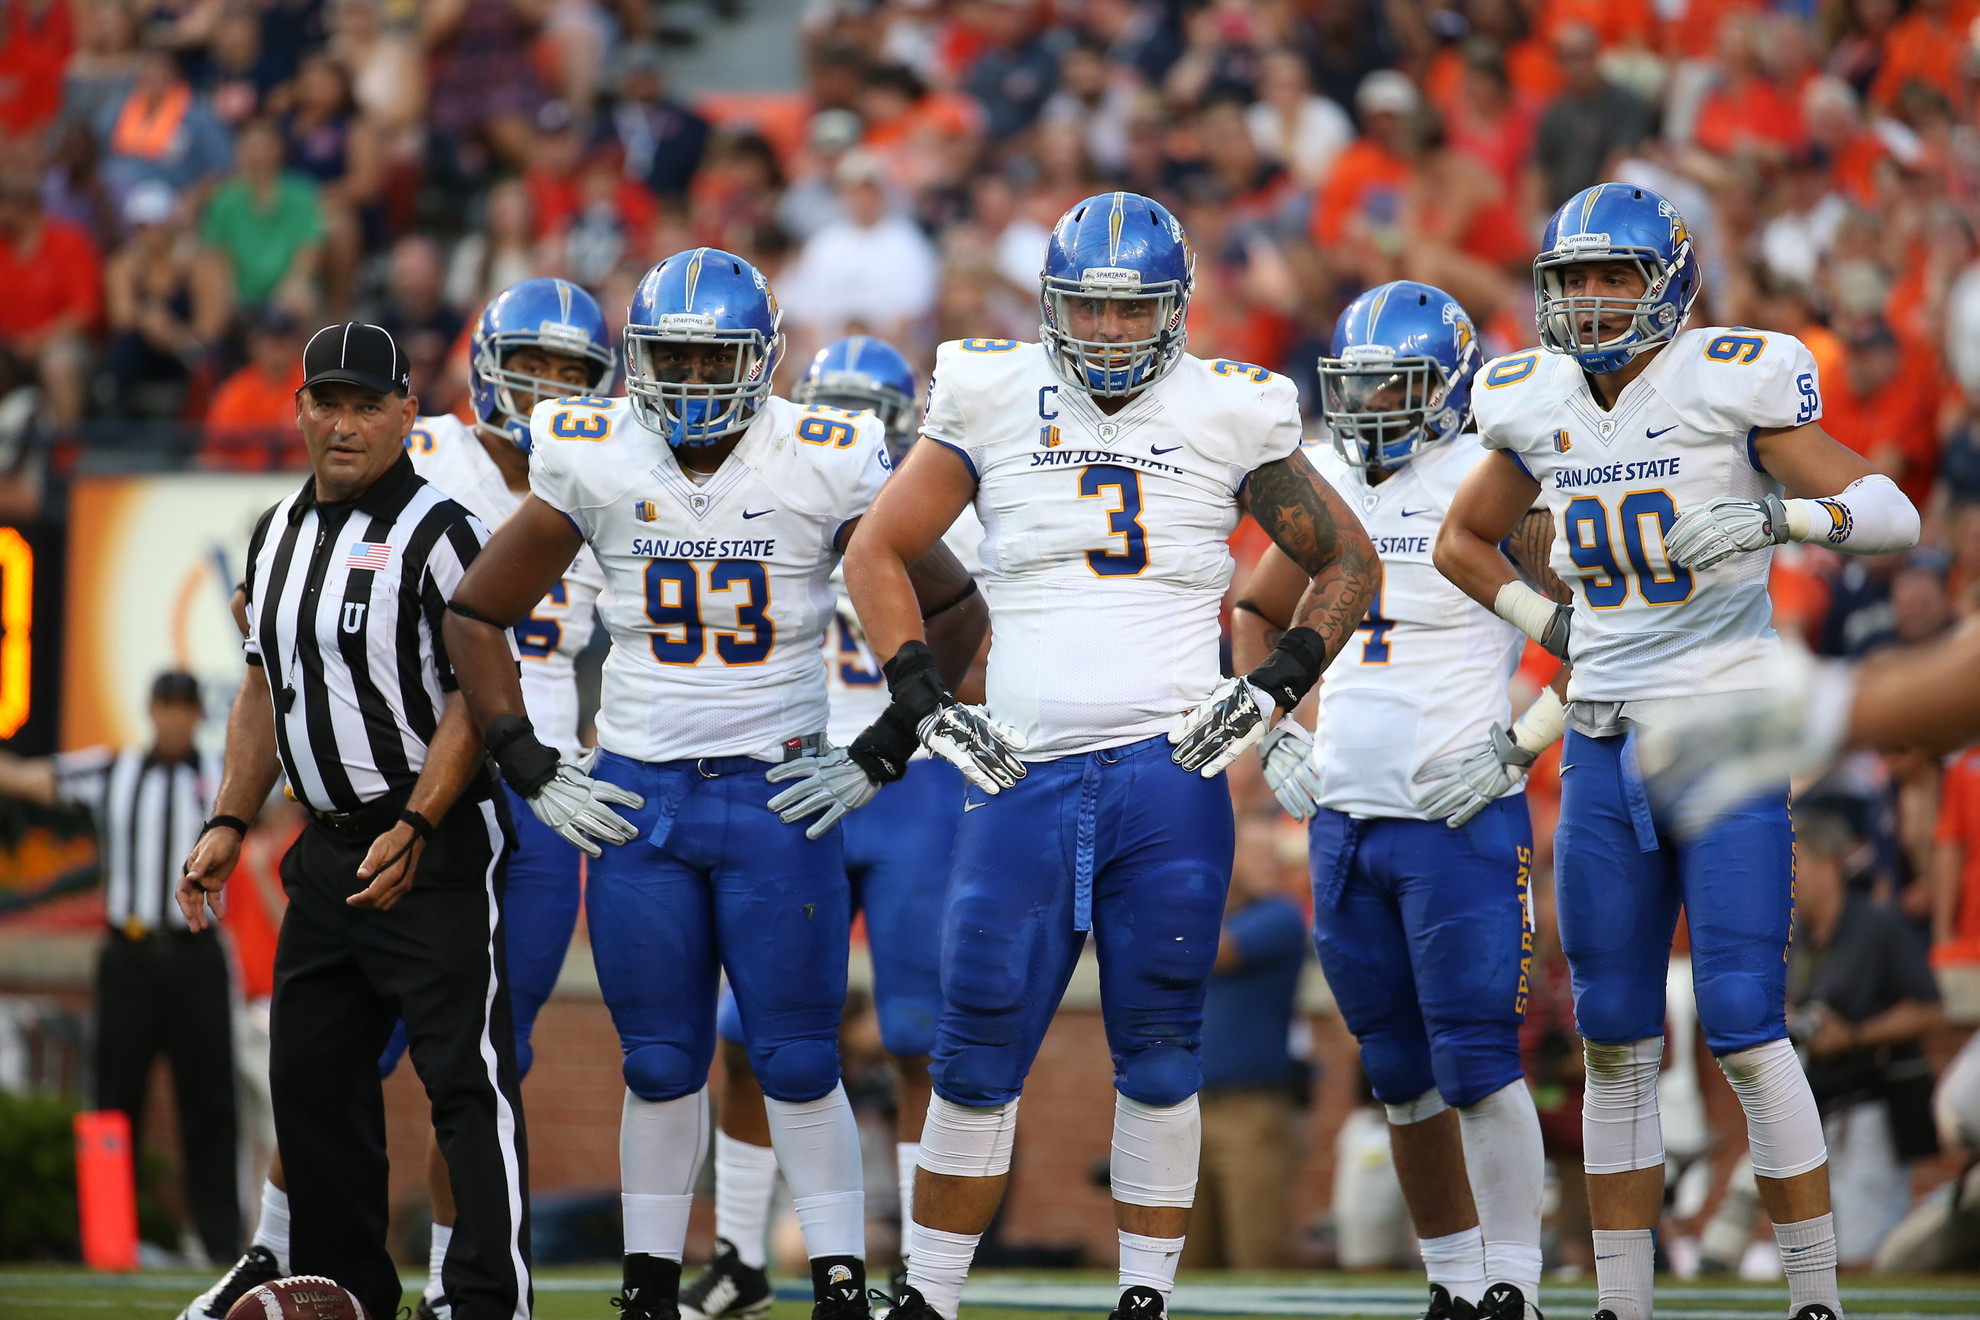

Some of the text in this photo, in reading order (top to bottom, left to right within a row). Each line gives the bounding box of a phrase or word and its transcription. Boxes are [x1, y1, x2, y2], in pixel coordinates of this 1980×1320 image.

[672, 317, 703, 325] SPARTANS
[1038, 385, 1058, 420] C
[1031, 451, 1072, 466] SAN
[1555, 457, 1681, 488] SAN JOSÉ STATE
[1077, 465, 1151, 579] 3
[632, 537, 776, 558] SAN JOSÉ STATE
[1379, 537, 1429, 554] STATE
[1563, 487, 1696, 611] 90
[342, 601, 366, 634] U
[643, 557, 776, 667] 93
[1515, 845, 1533, 1016] SPARTANS
[290, 1290, 342, 1304] Wilson
